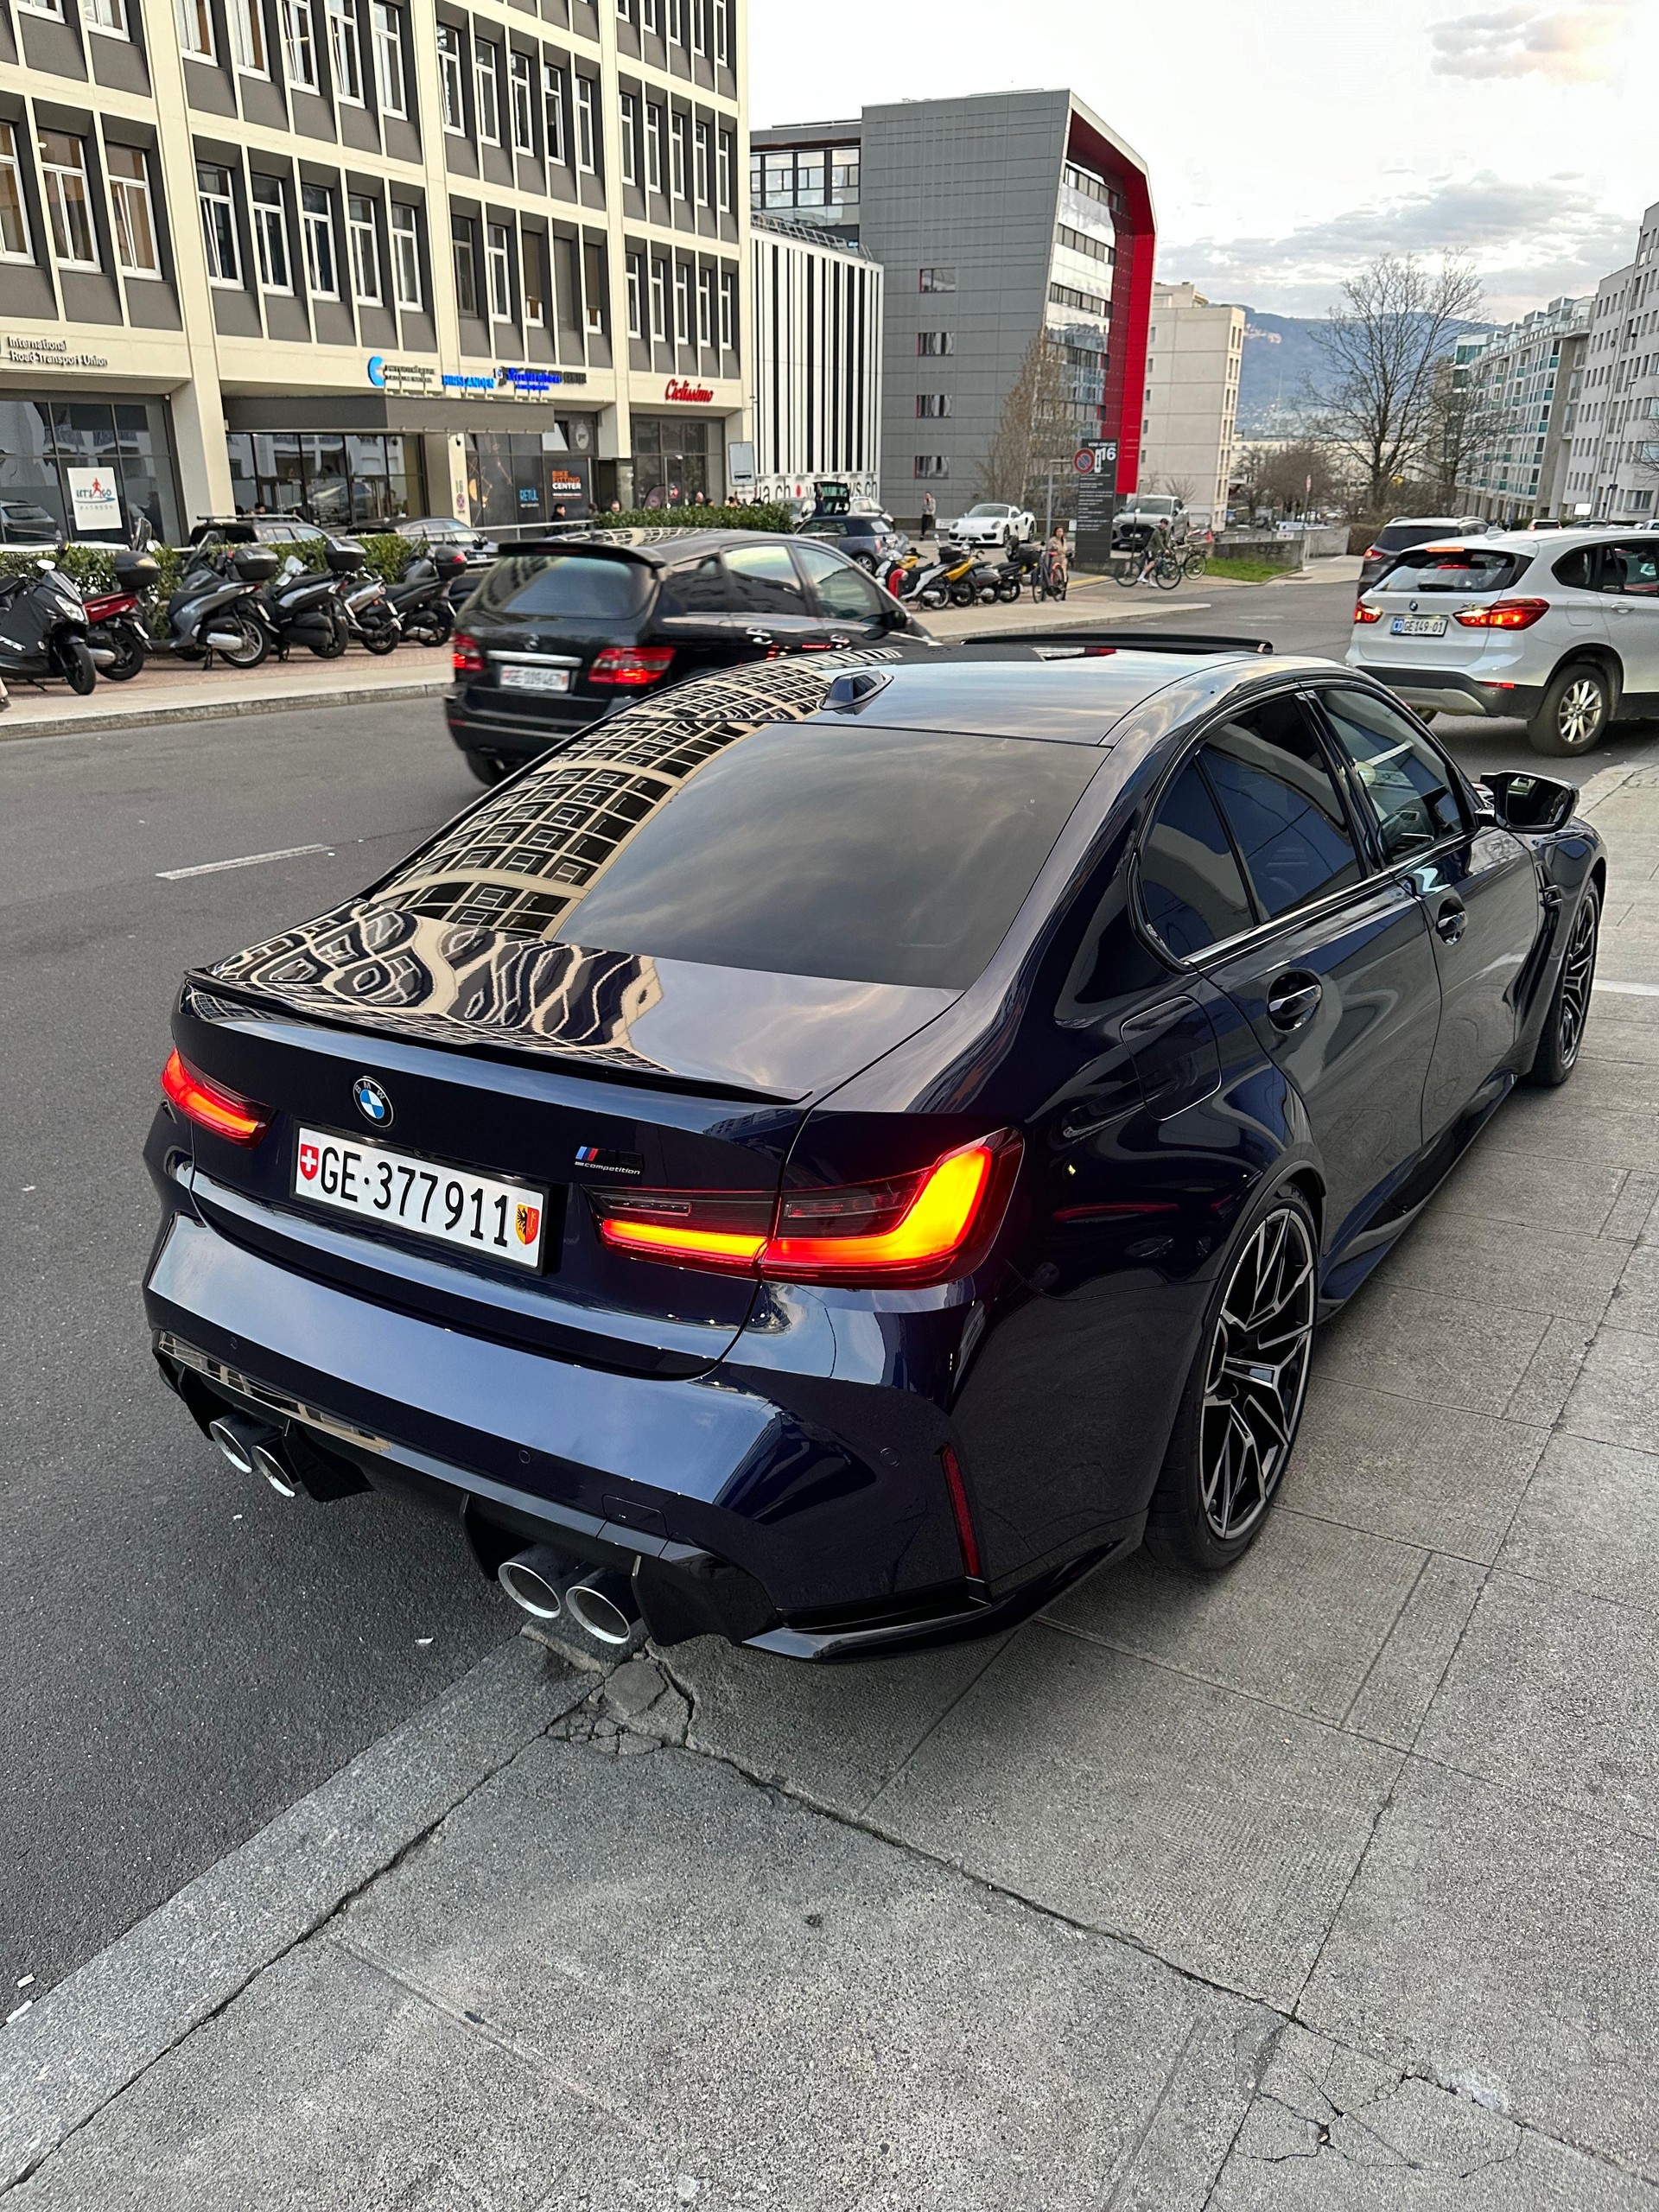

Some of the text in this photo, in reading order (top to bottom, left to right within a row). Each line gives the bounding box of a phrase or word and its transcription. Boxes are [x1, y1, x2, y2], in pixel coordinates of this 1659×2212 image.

[8, 336, 67, 352] International
[10, 350, 108, 366] Road Transport Union
[664, 378, 714, 403] Ciclissimo
[102, 488, 112, 497] GO
[354, 1080, 385, 1100] BMW
[584, 1162, 641, 1175] competition
